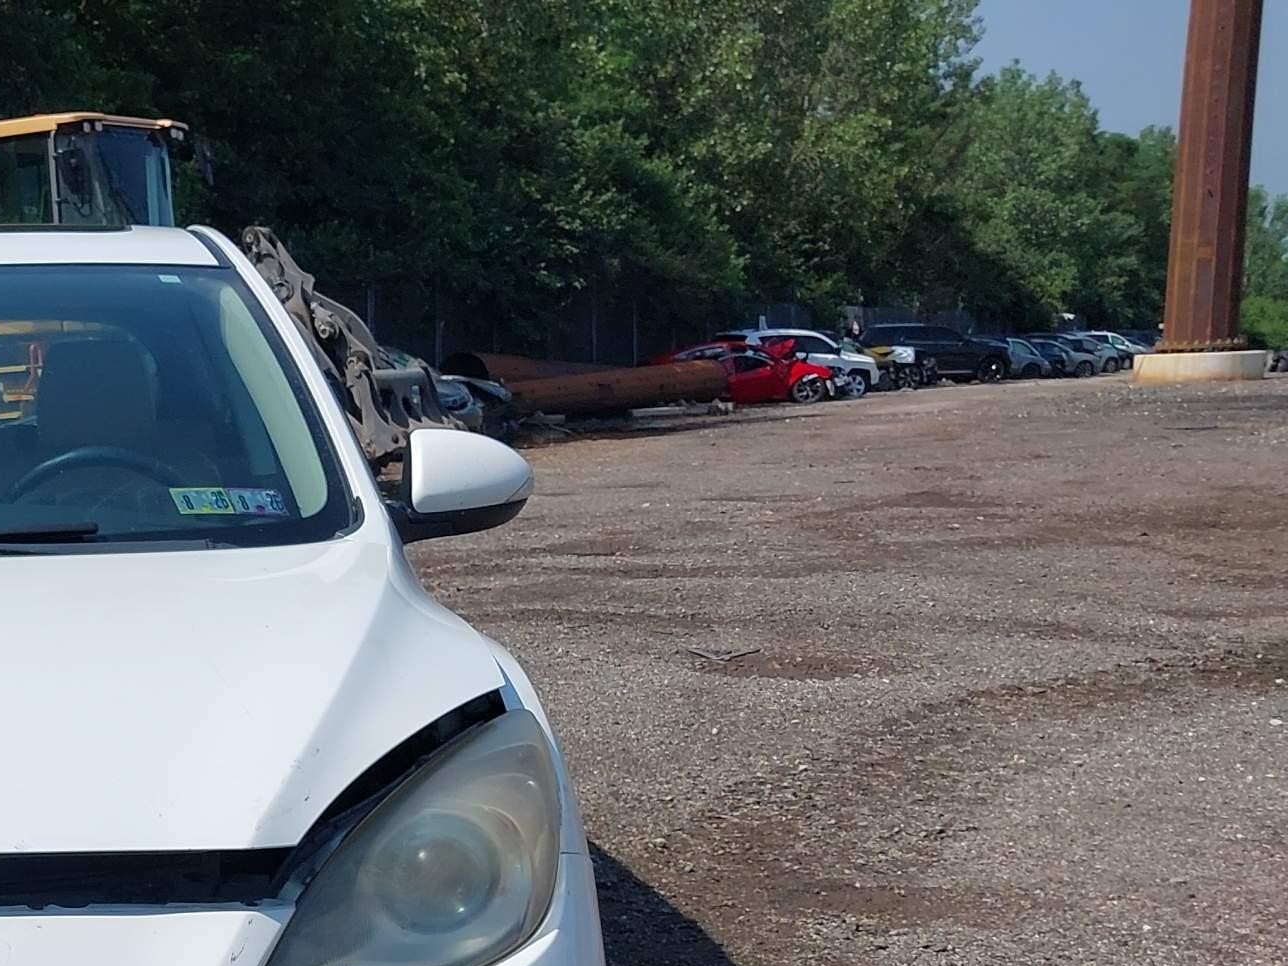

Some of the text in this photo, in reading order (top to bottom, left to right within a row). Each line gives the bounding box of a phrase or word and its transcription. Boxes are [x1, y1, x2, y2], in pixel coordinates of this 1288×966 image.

[182, 491, 229, 511] 8 26
[238, 494, 250, 511] 8
